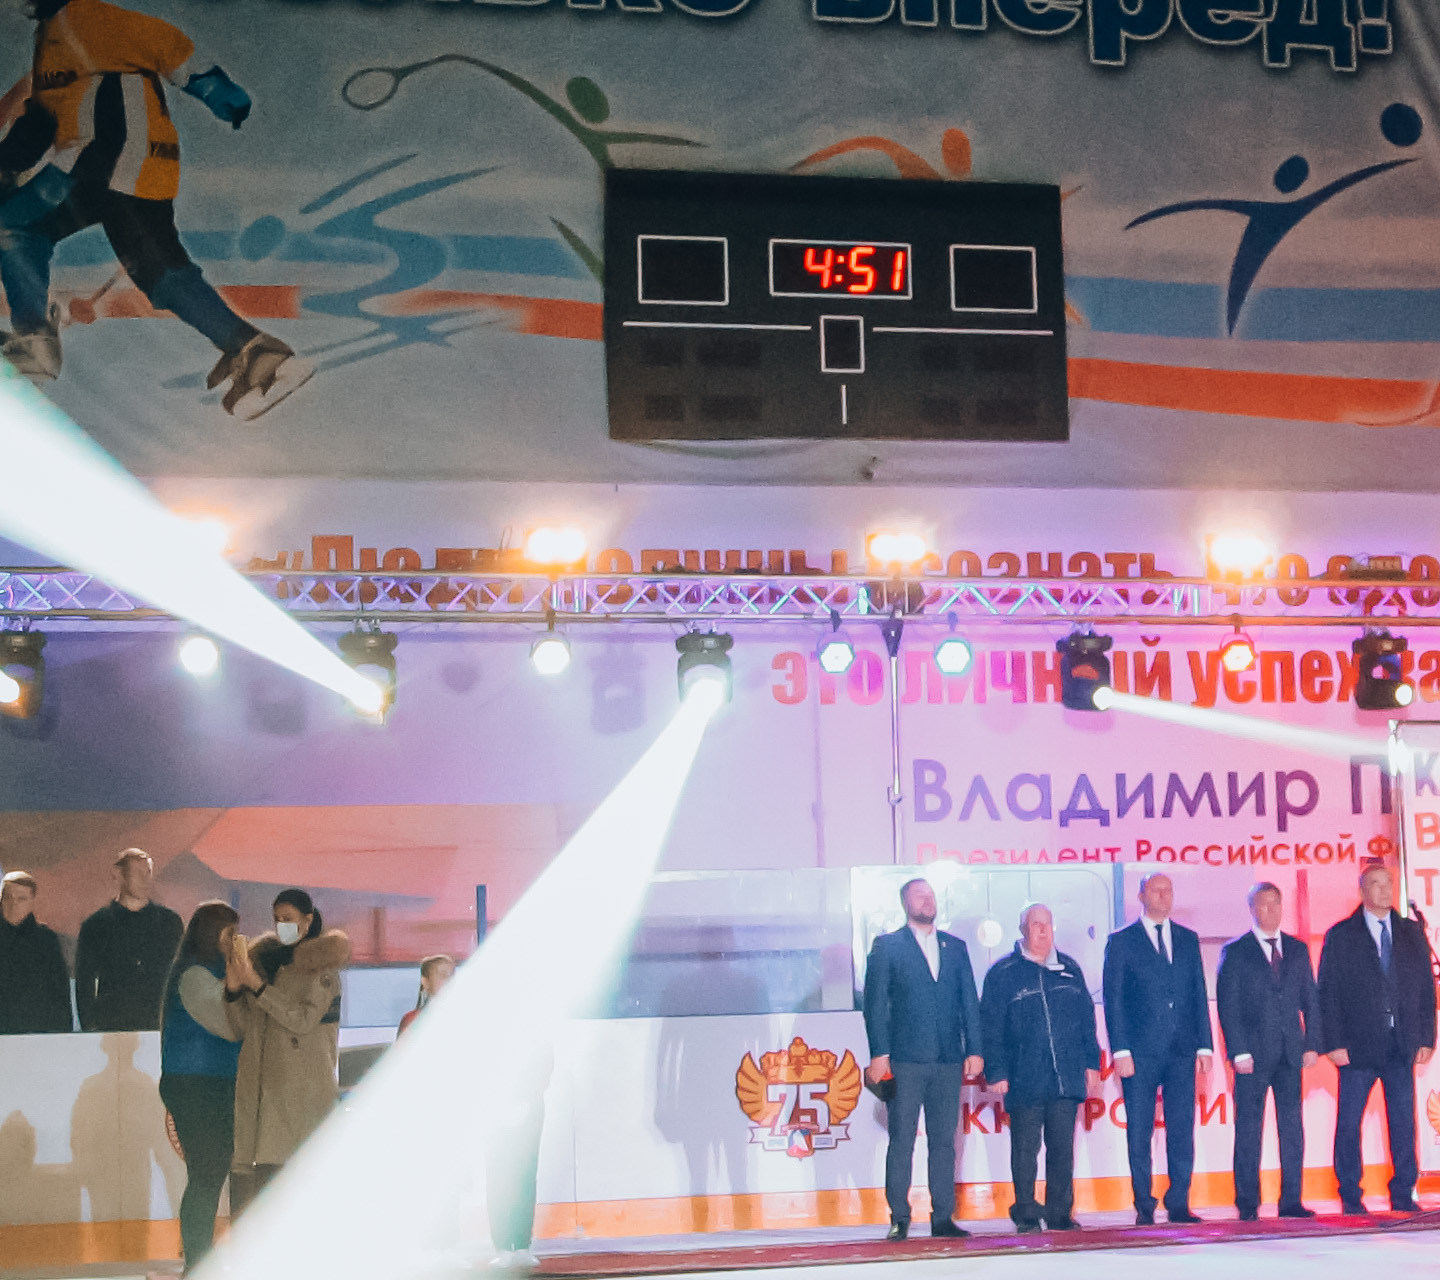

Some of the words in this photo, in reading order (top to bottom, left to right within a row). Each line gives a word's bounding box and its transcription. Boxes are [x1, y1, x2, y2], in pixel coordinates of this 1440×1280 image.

[804, 246, 904, 292] 4:51
[899, 636, 1173, 705] личнй
[913, 758, 1320, 833] Владимир
[1136, 833, 1357, 866] Российской
[768, 1083, 830, 1136] 75
